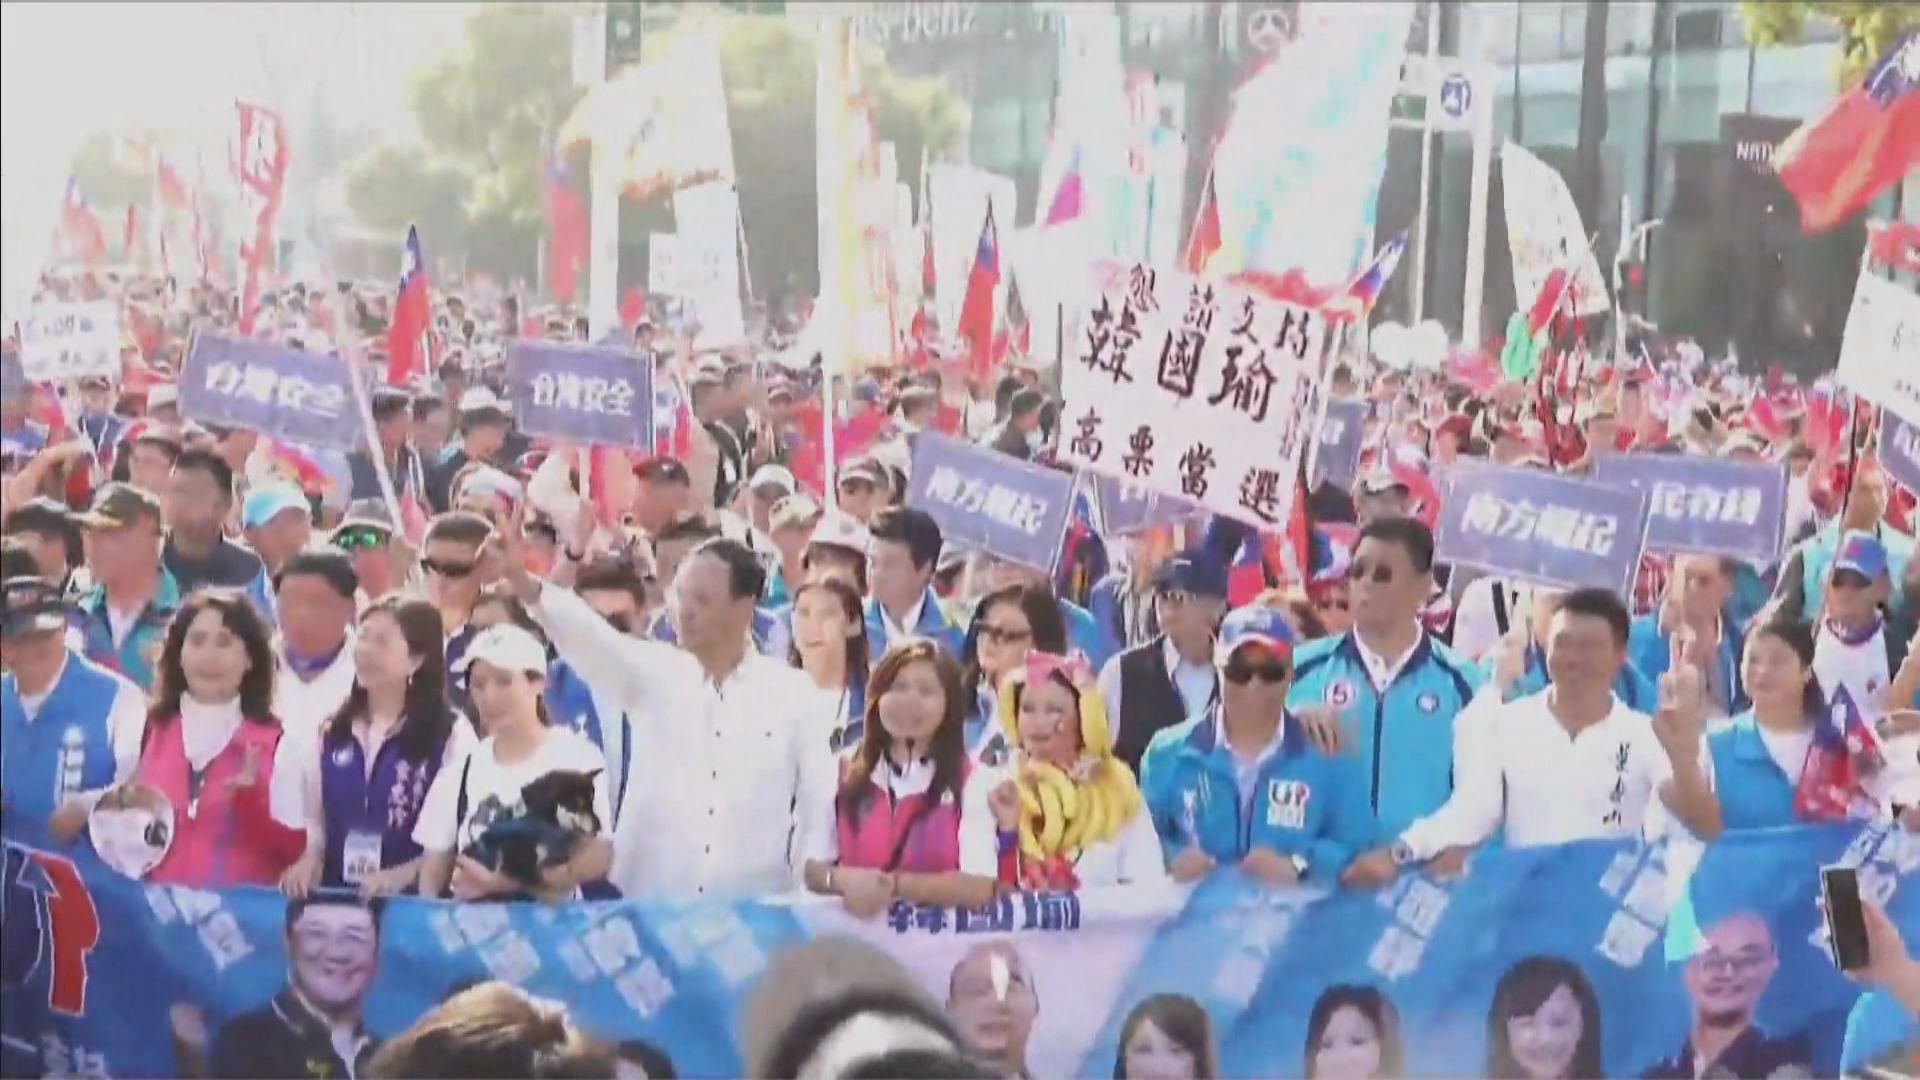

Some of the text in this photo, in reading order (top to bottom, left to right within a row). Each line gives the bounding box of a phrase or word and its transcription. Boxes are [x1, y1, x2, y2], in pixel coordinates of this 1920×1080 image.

[531, 372, 635, 416] 台灣安全
[1079, 292, 1278, 422] 韓國瑜
[1071, 405, 1280, 524] 高票當選
[1460, 492, 1618, 556] 南方崛起
